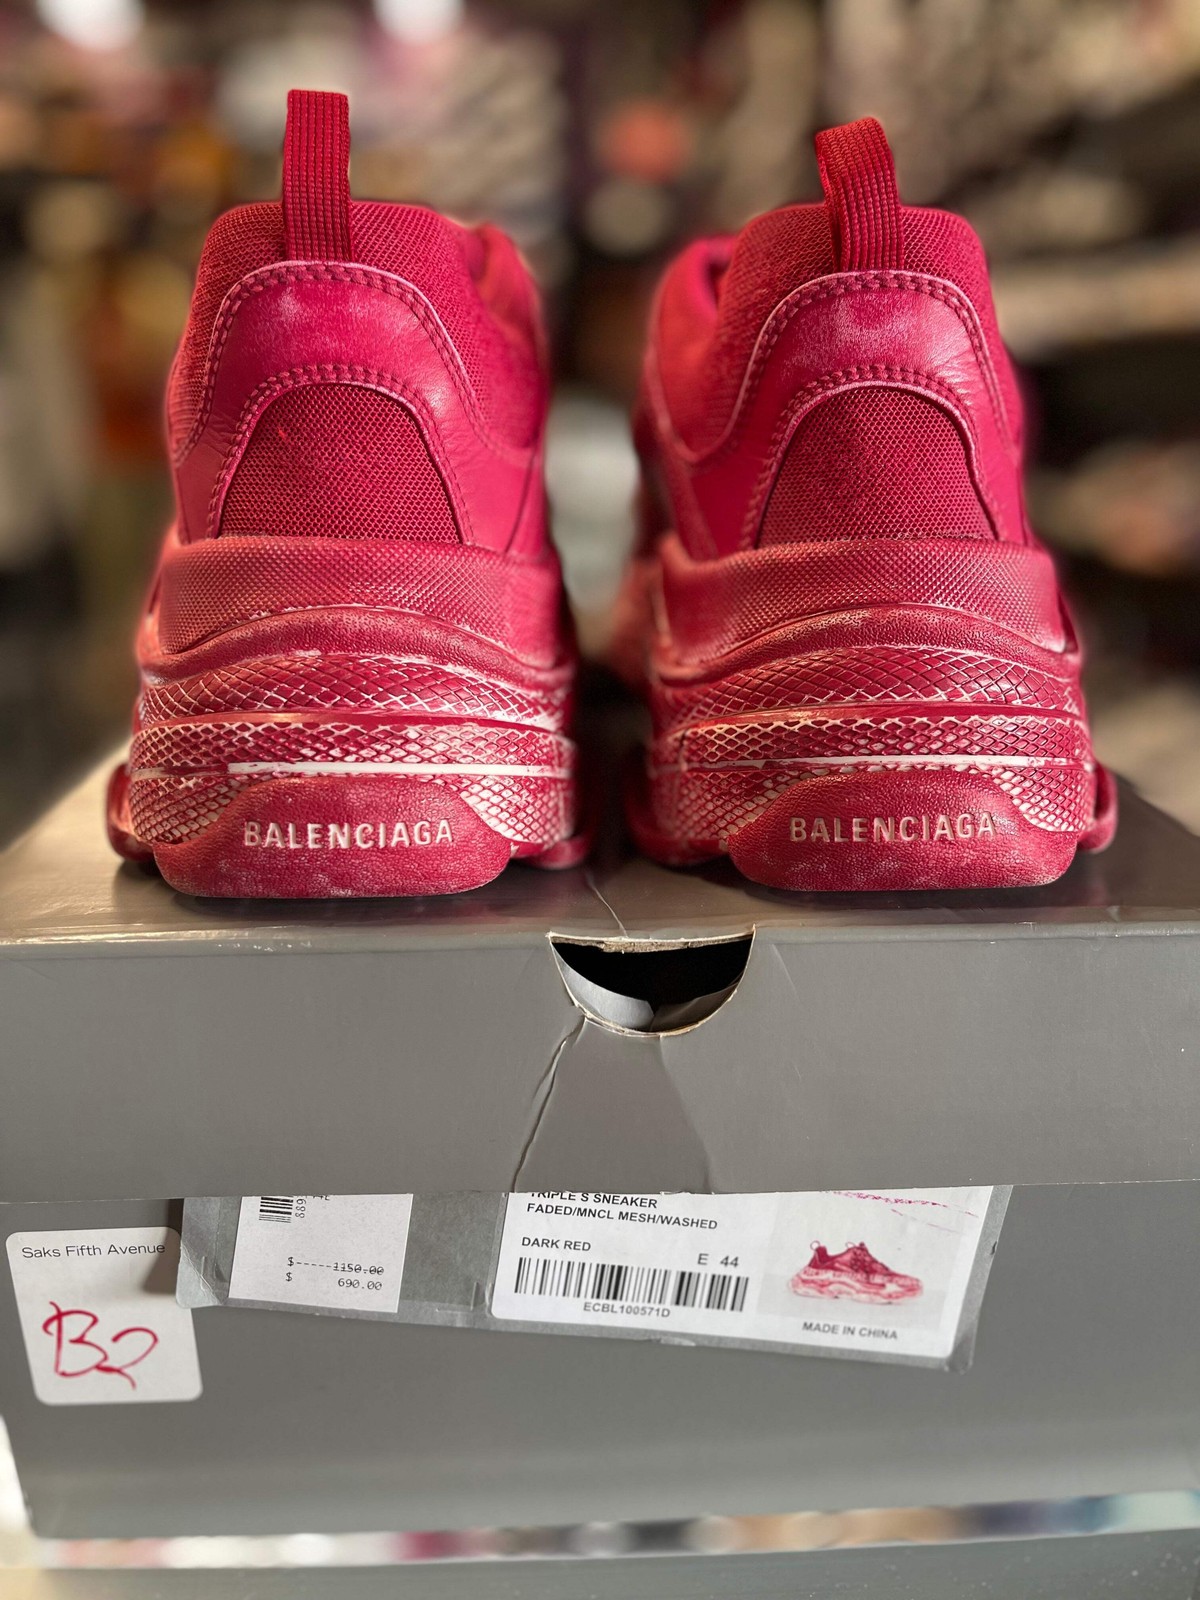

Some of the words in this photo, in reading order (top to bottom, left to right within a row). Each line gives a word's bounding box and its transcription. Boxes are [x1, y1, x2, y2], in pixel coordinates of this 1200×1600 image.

[244, 819, 453, 849] BALENCIAGA
[790, 812, 997, 842] BALENCIAGA
[580, 1192, 589, 1202] S
[593, 1193, 658, 1209] SNEAKER
[527, 1203, 614, 1219] FADED/MNCL
[618, 1210, 718, 1230] MESH/WASHED
[22, 1246, 61, 1259] Saks
[65, 1245, 102, 1257] Fifth
[107, 1243, 166, 1255] Avenue
[521, 1237, 560, 1249] DARK
[563, 1240, 591, 1252] RED
[697, 1253, 709, 1265] E
[720, 1256, 739, 1268] 44
[337, 1278, 382, 1290] 690.00
[583, 1302, 671, 1318] ECBL100571D
[801, 1321, 839, 1335] MADE
[843, 1324, 855, 1336] IN
[859, 1327, 898, 1340] CHINA
